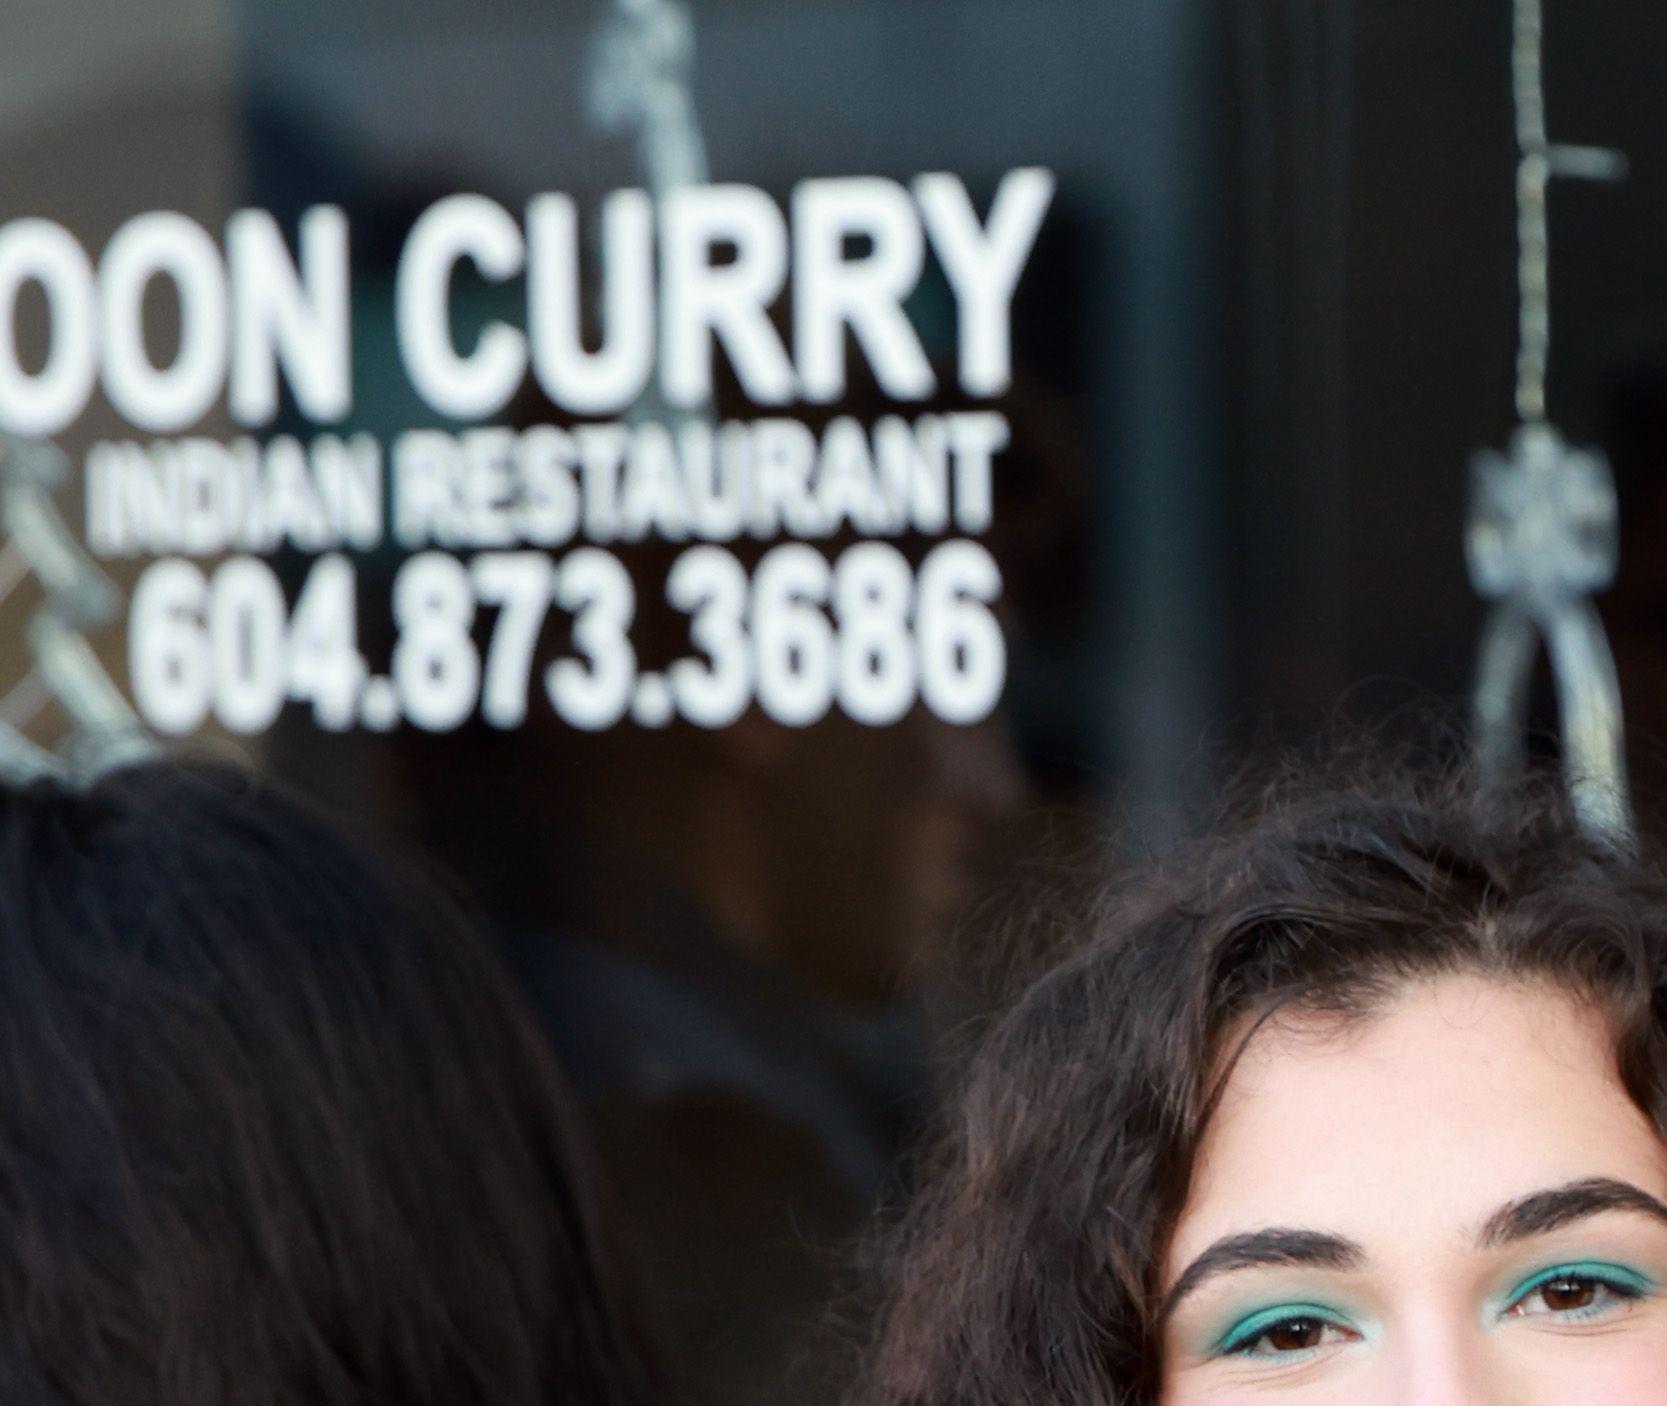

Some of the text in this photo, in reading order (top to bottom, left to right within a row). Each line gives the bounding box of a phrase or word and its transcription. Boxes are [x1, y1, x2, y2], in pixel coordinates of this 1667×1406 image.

[0, 167, 1053, 437] OON CURRY
[86, 411, 1007, 555] INDIAN RESTAURANT
[129, 540, 1005, 737] 604.873.3686
